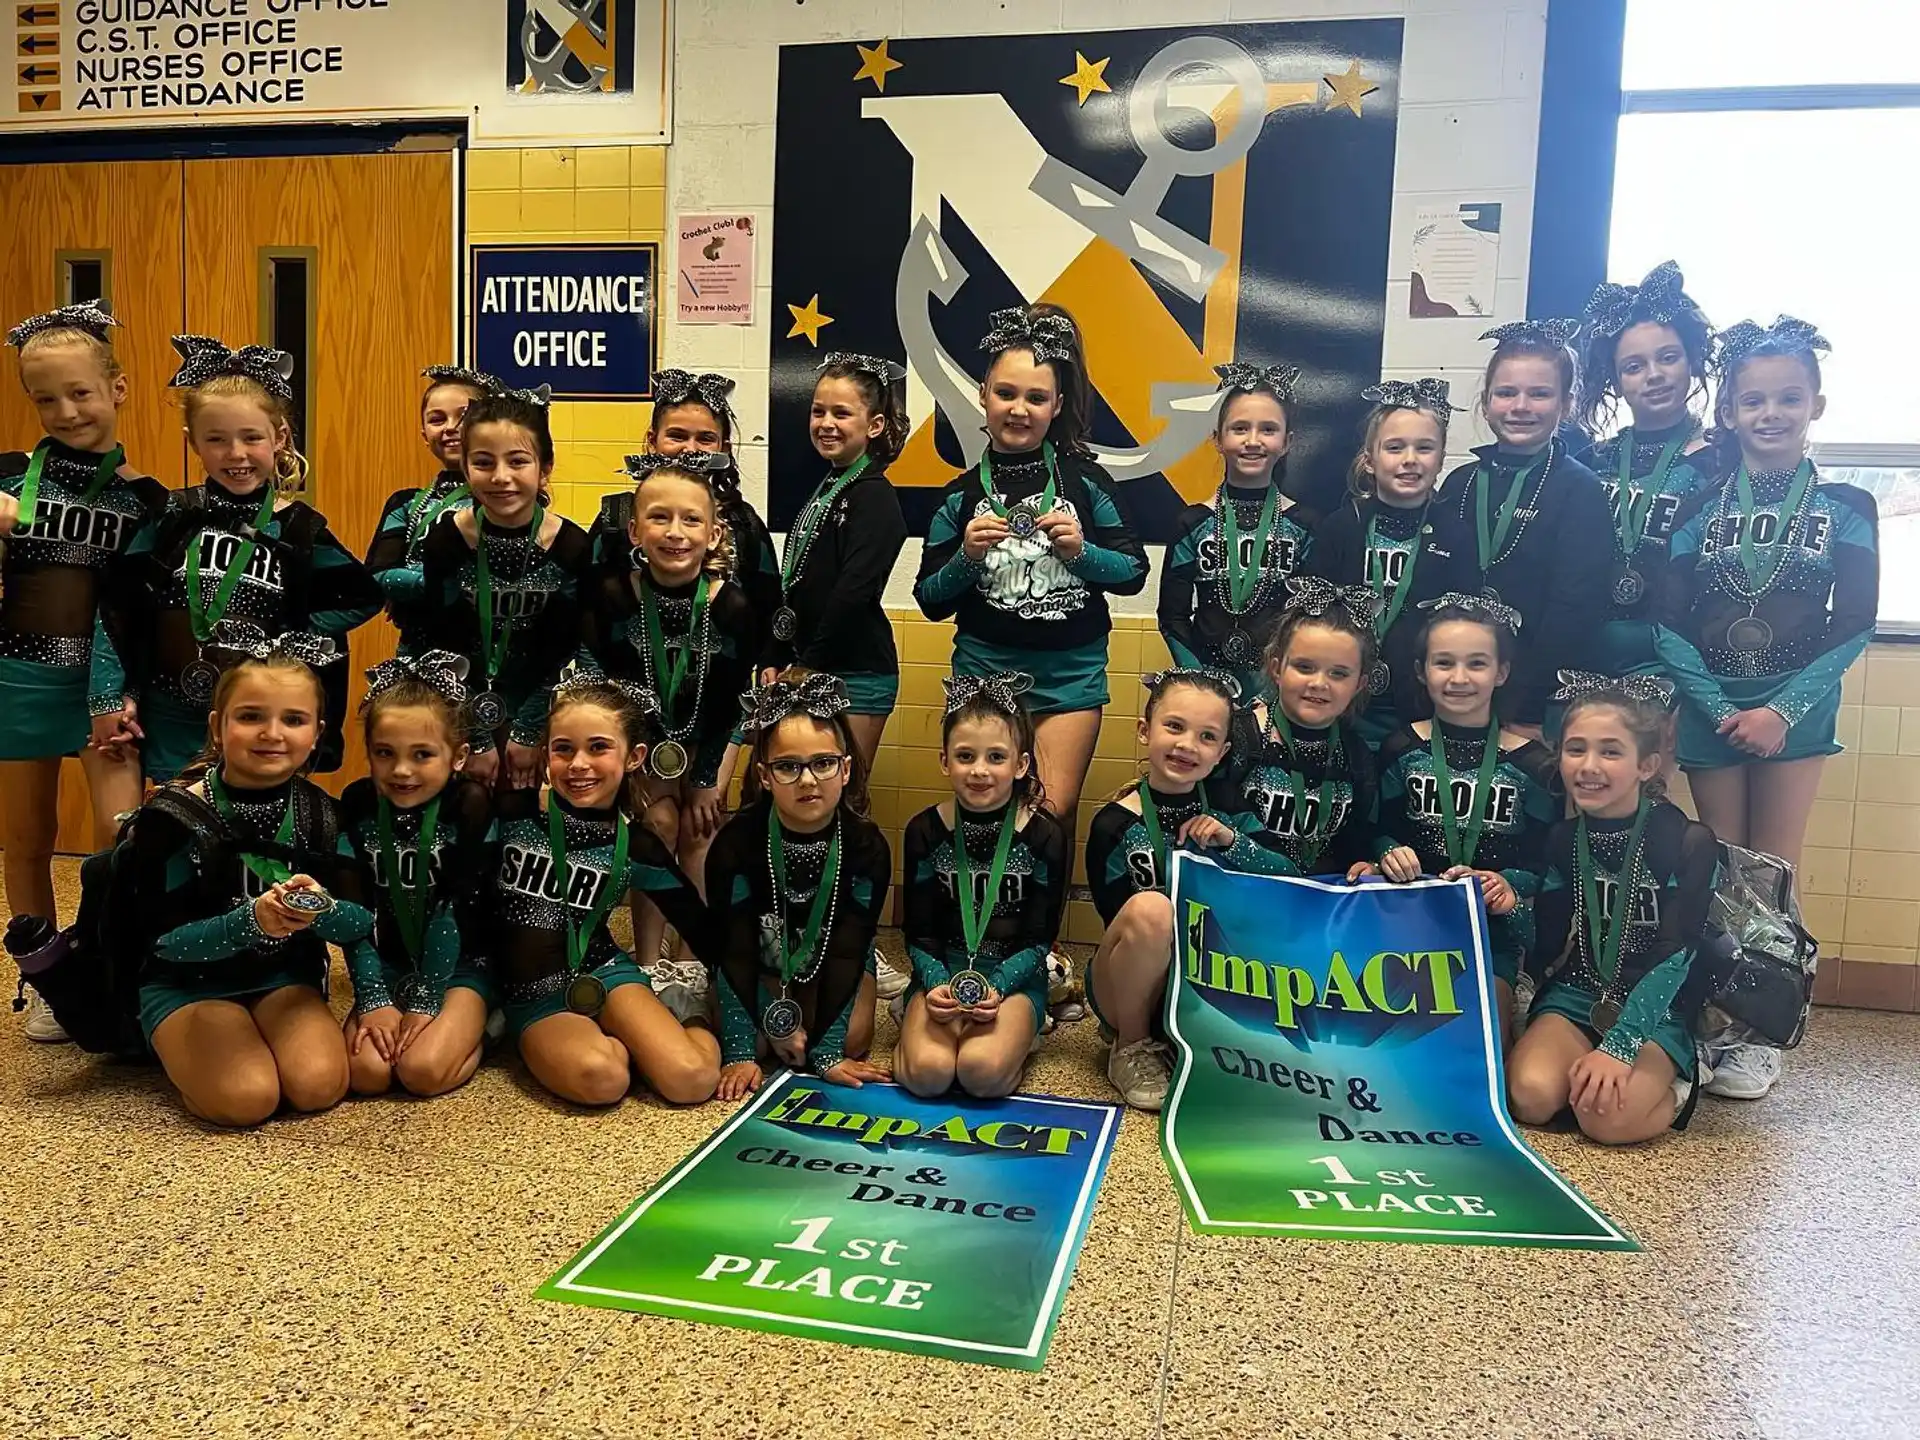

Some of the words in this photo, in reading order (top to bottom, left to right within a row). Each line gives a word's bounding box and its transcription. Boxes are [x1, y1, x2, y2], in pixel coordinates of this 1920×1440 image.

[76, 0, 247, 25] GUIDANCE
[76, 26, 159, 53] C.S.T.
[174, 19, 296, 49] OFFICE
[76, 53, 204, 83] NURSES
[221, 47, 343, 76] OFFICE
[76, 78, 304, 110] ATTENDANCE
[681, 226, 712, 240] Crochet
[713, 218, 735, 231] Club!
[481, 276, 645, 314] ATTENDANCE
[681, 304, 692, 313] Try
[513, 330, 607, 367] OFFICE
[499, 843, 610, 911] SHOR
[1184, 898, 1467, 1030] ImpACT
[1211, 1045, 1336, 1101] Cheer
[1346, 1077, 1383, 1114] &
[761, 1087, 1088, 1156] ImpACT
[1317, 1112, 1484, 1148] Dance
[736, 1146, 895, 1180] Cheer
[905, 1166, 948, 1188] &
[847, 1182, 1036, 1223] Dance
[1288, 1188, 1497, 1218] PLACE
[696, 1254, 933, 1311] PLACE
